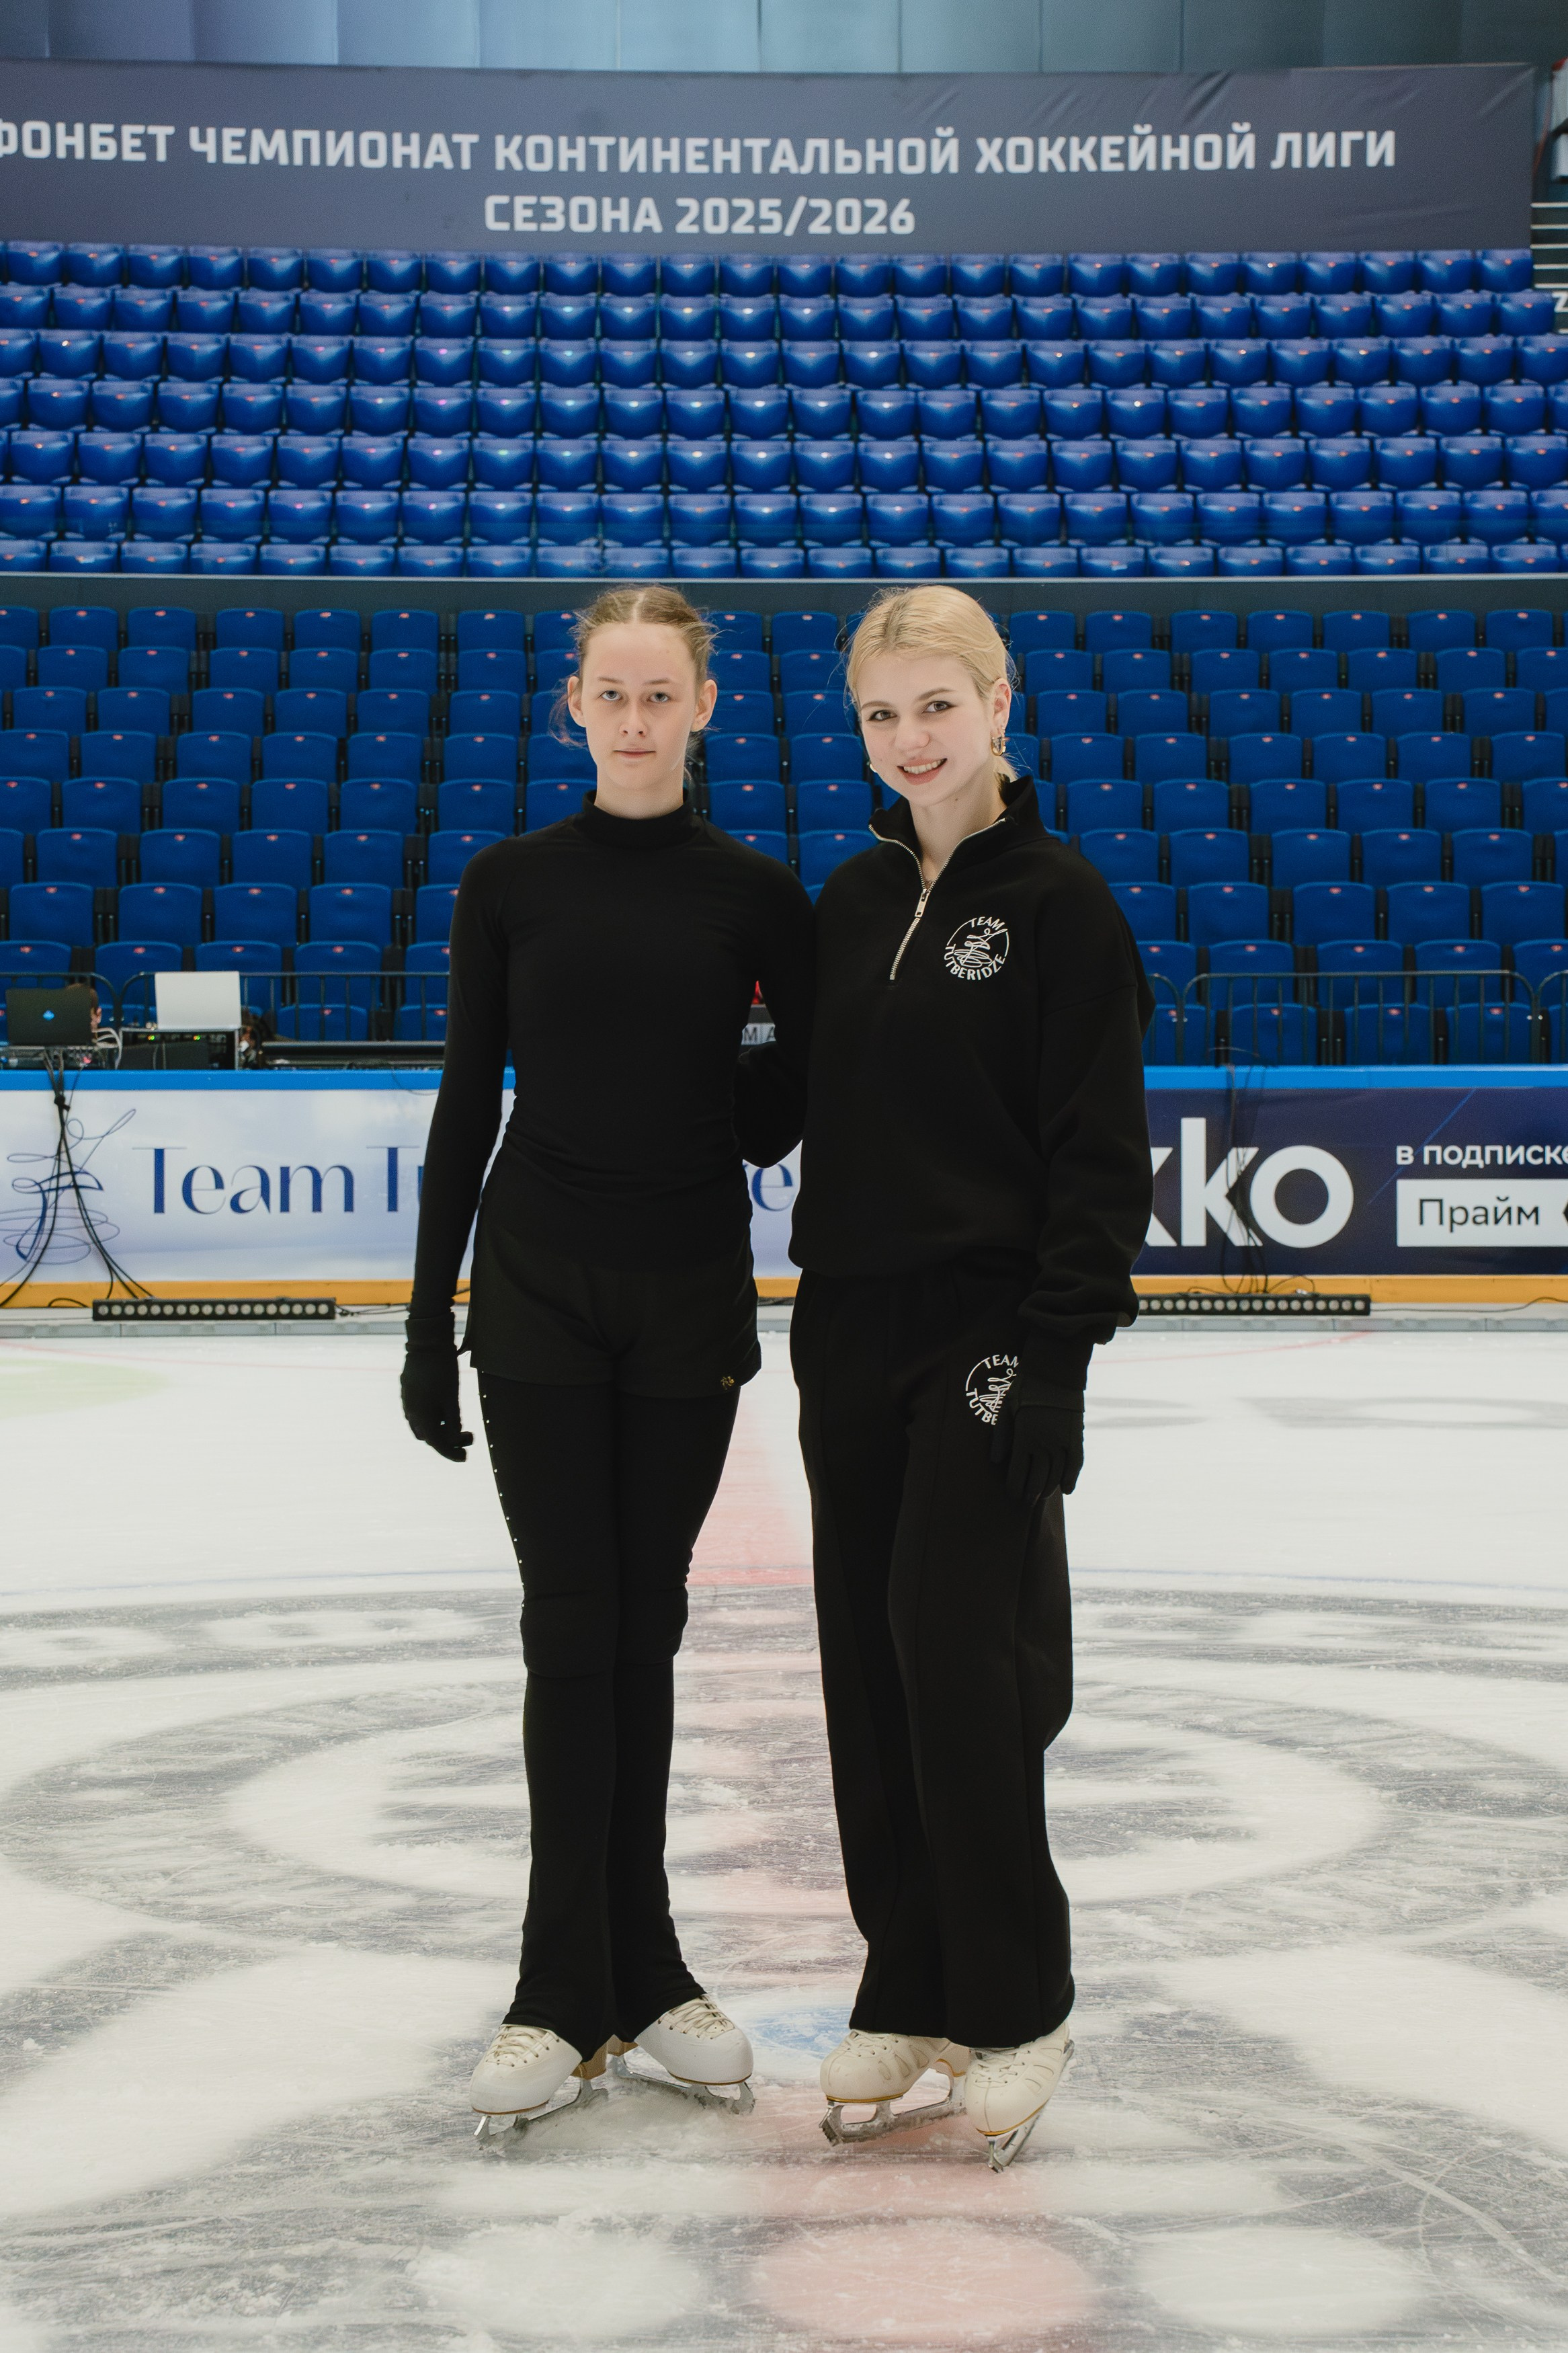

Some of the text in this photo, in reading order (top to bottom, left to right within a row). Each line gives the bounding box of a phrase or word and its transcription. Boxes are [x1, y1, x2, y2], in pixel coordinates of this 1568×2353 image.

[188, 126, 480, 170] ЧЕМПИОНАТ
[494, 126, 959, 175] КОНТИНЕНТАЛЬНОЙ
[975, 121, 1255, 173] ХОККЕЙНОЙ
[1270, 130, 1395, 169] ЛИГИ
[484, 194, 916, 237] СЕЗОНА 2025/2026
[970, 916, 1005, 930] TEAM
[944, 943, 1006, 981] TUTBERIDZE
[1396, 1145, 1415, 1165] в
[132, 1146, 355, 1215] Team
[1418, 1195, 1540, 1234] Прайм
